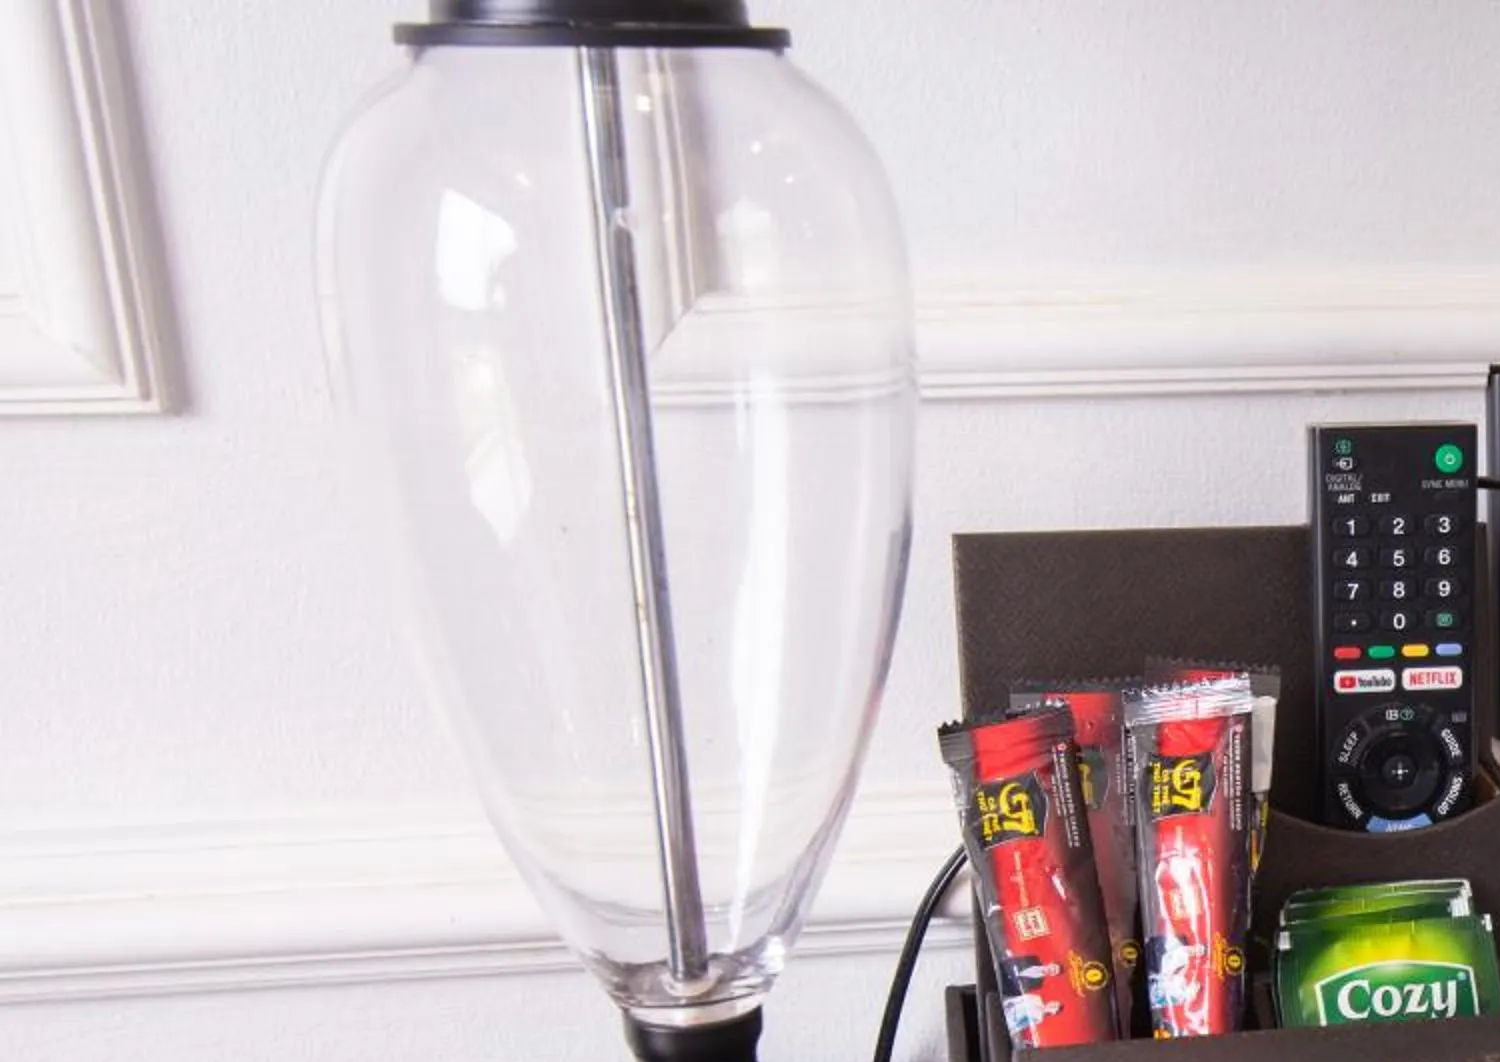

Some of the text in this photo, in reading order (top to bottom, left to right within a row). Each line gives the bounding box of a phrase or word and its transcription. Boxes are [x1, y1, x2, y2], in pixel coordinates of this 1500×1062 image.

[1346, 516, 1451, 537] 1 2 3
[1345, 549, 1451, 568] 4 5 6
[1347, 580, 1451, 600] 7 8 9
[1393, 613, 1406, 630] 0
[1358, 675, 1393, 688] YouTube
[1409, 672, 1457, 686] NETFLIX
[1437, 775, 1463, 816] OPTIONS
[1337, 979, 1459, 1019] Cozy
